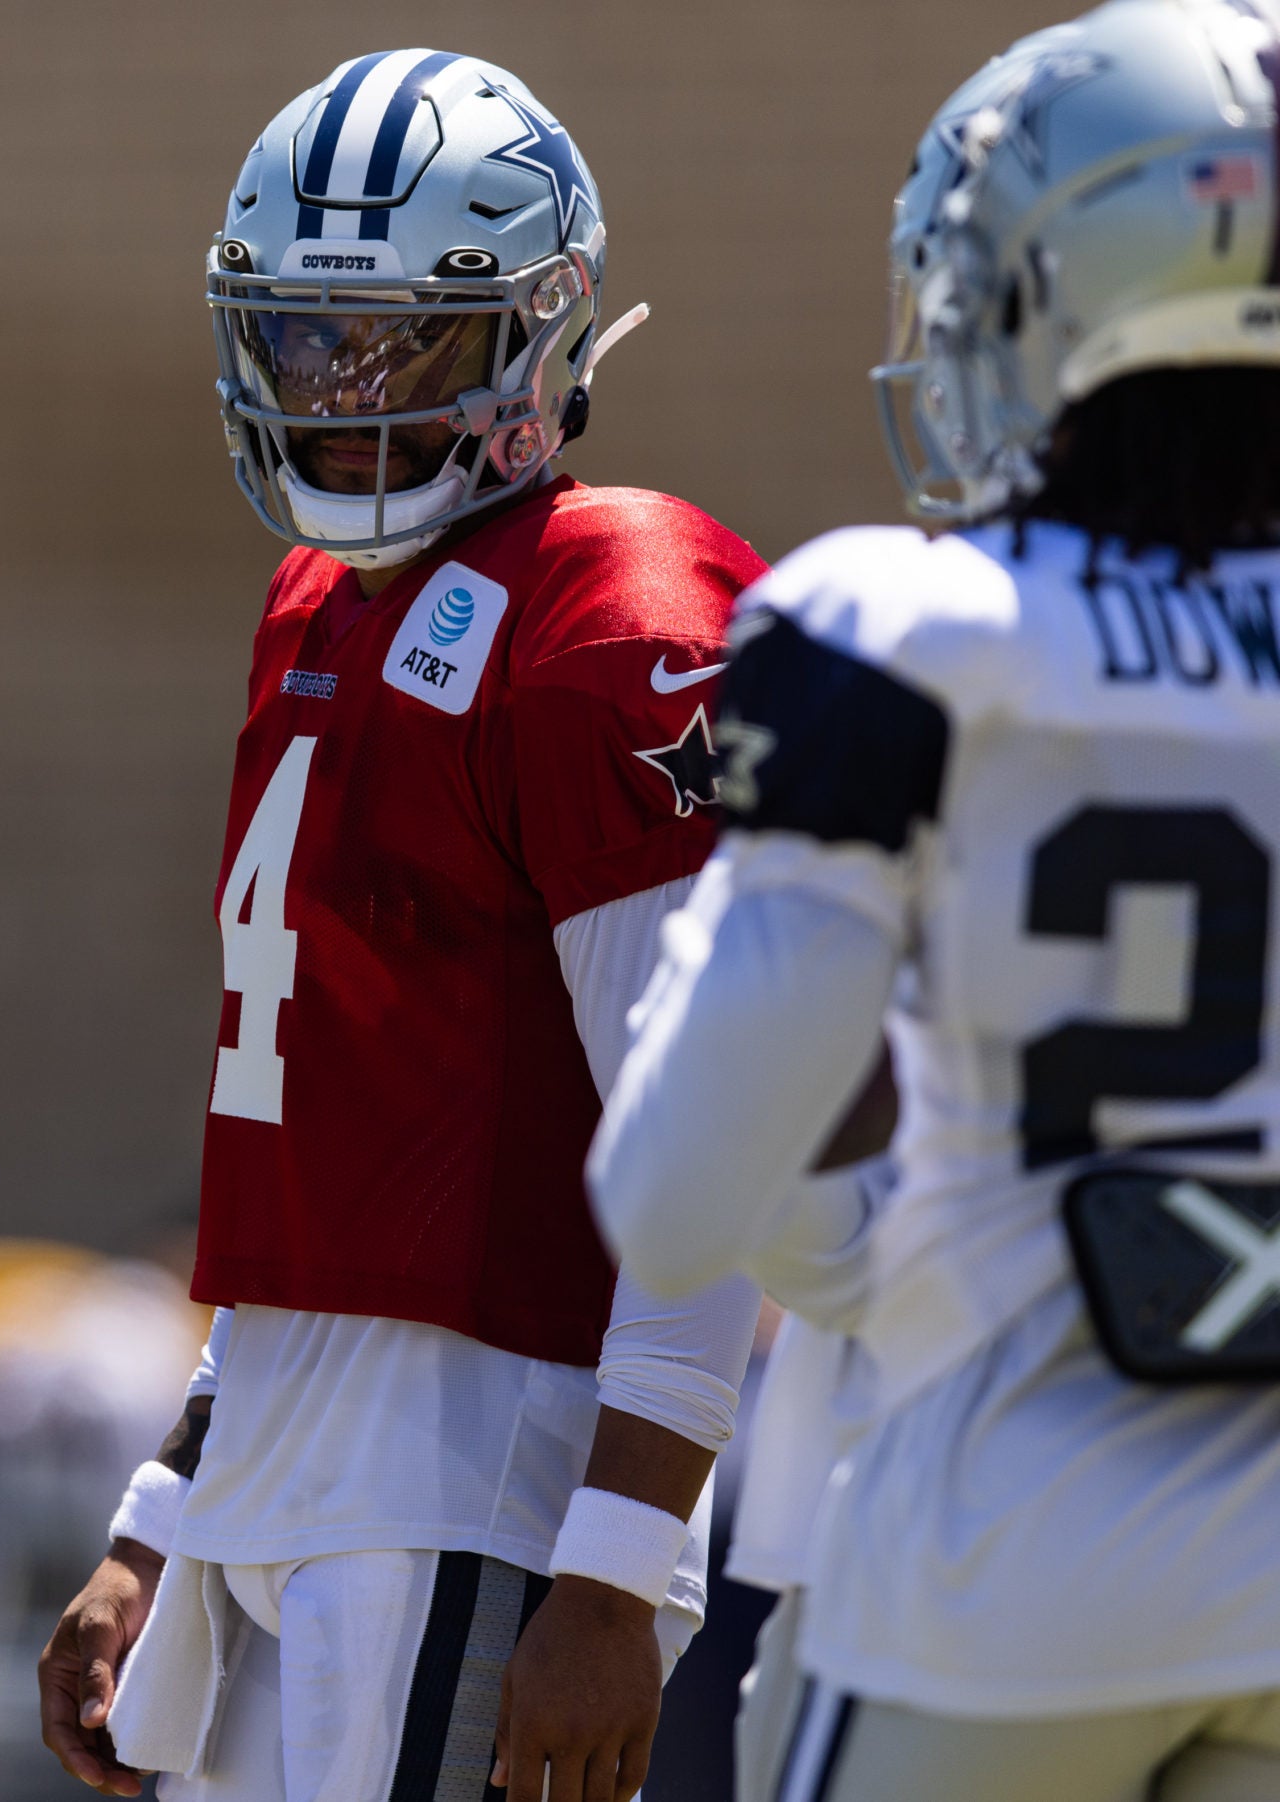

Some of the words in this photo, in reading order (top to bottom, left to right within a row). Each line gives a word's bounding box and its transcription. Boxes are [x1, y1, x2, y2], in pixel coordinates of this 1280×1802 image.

[301, 254, 376, 271] COWBOYS
[400, 646, 458, 689] AT&T
[210, 735, 318, 1125] 4
